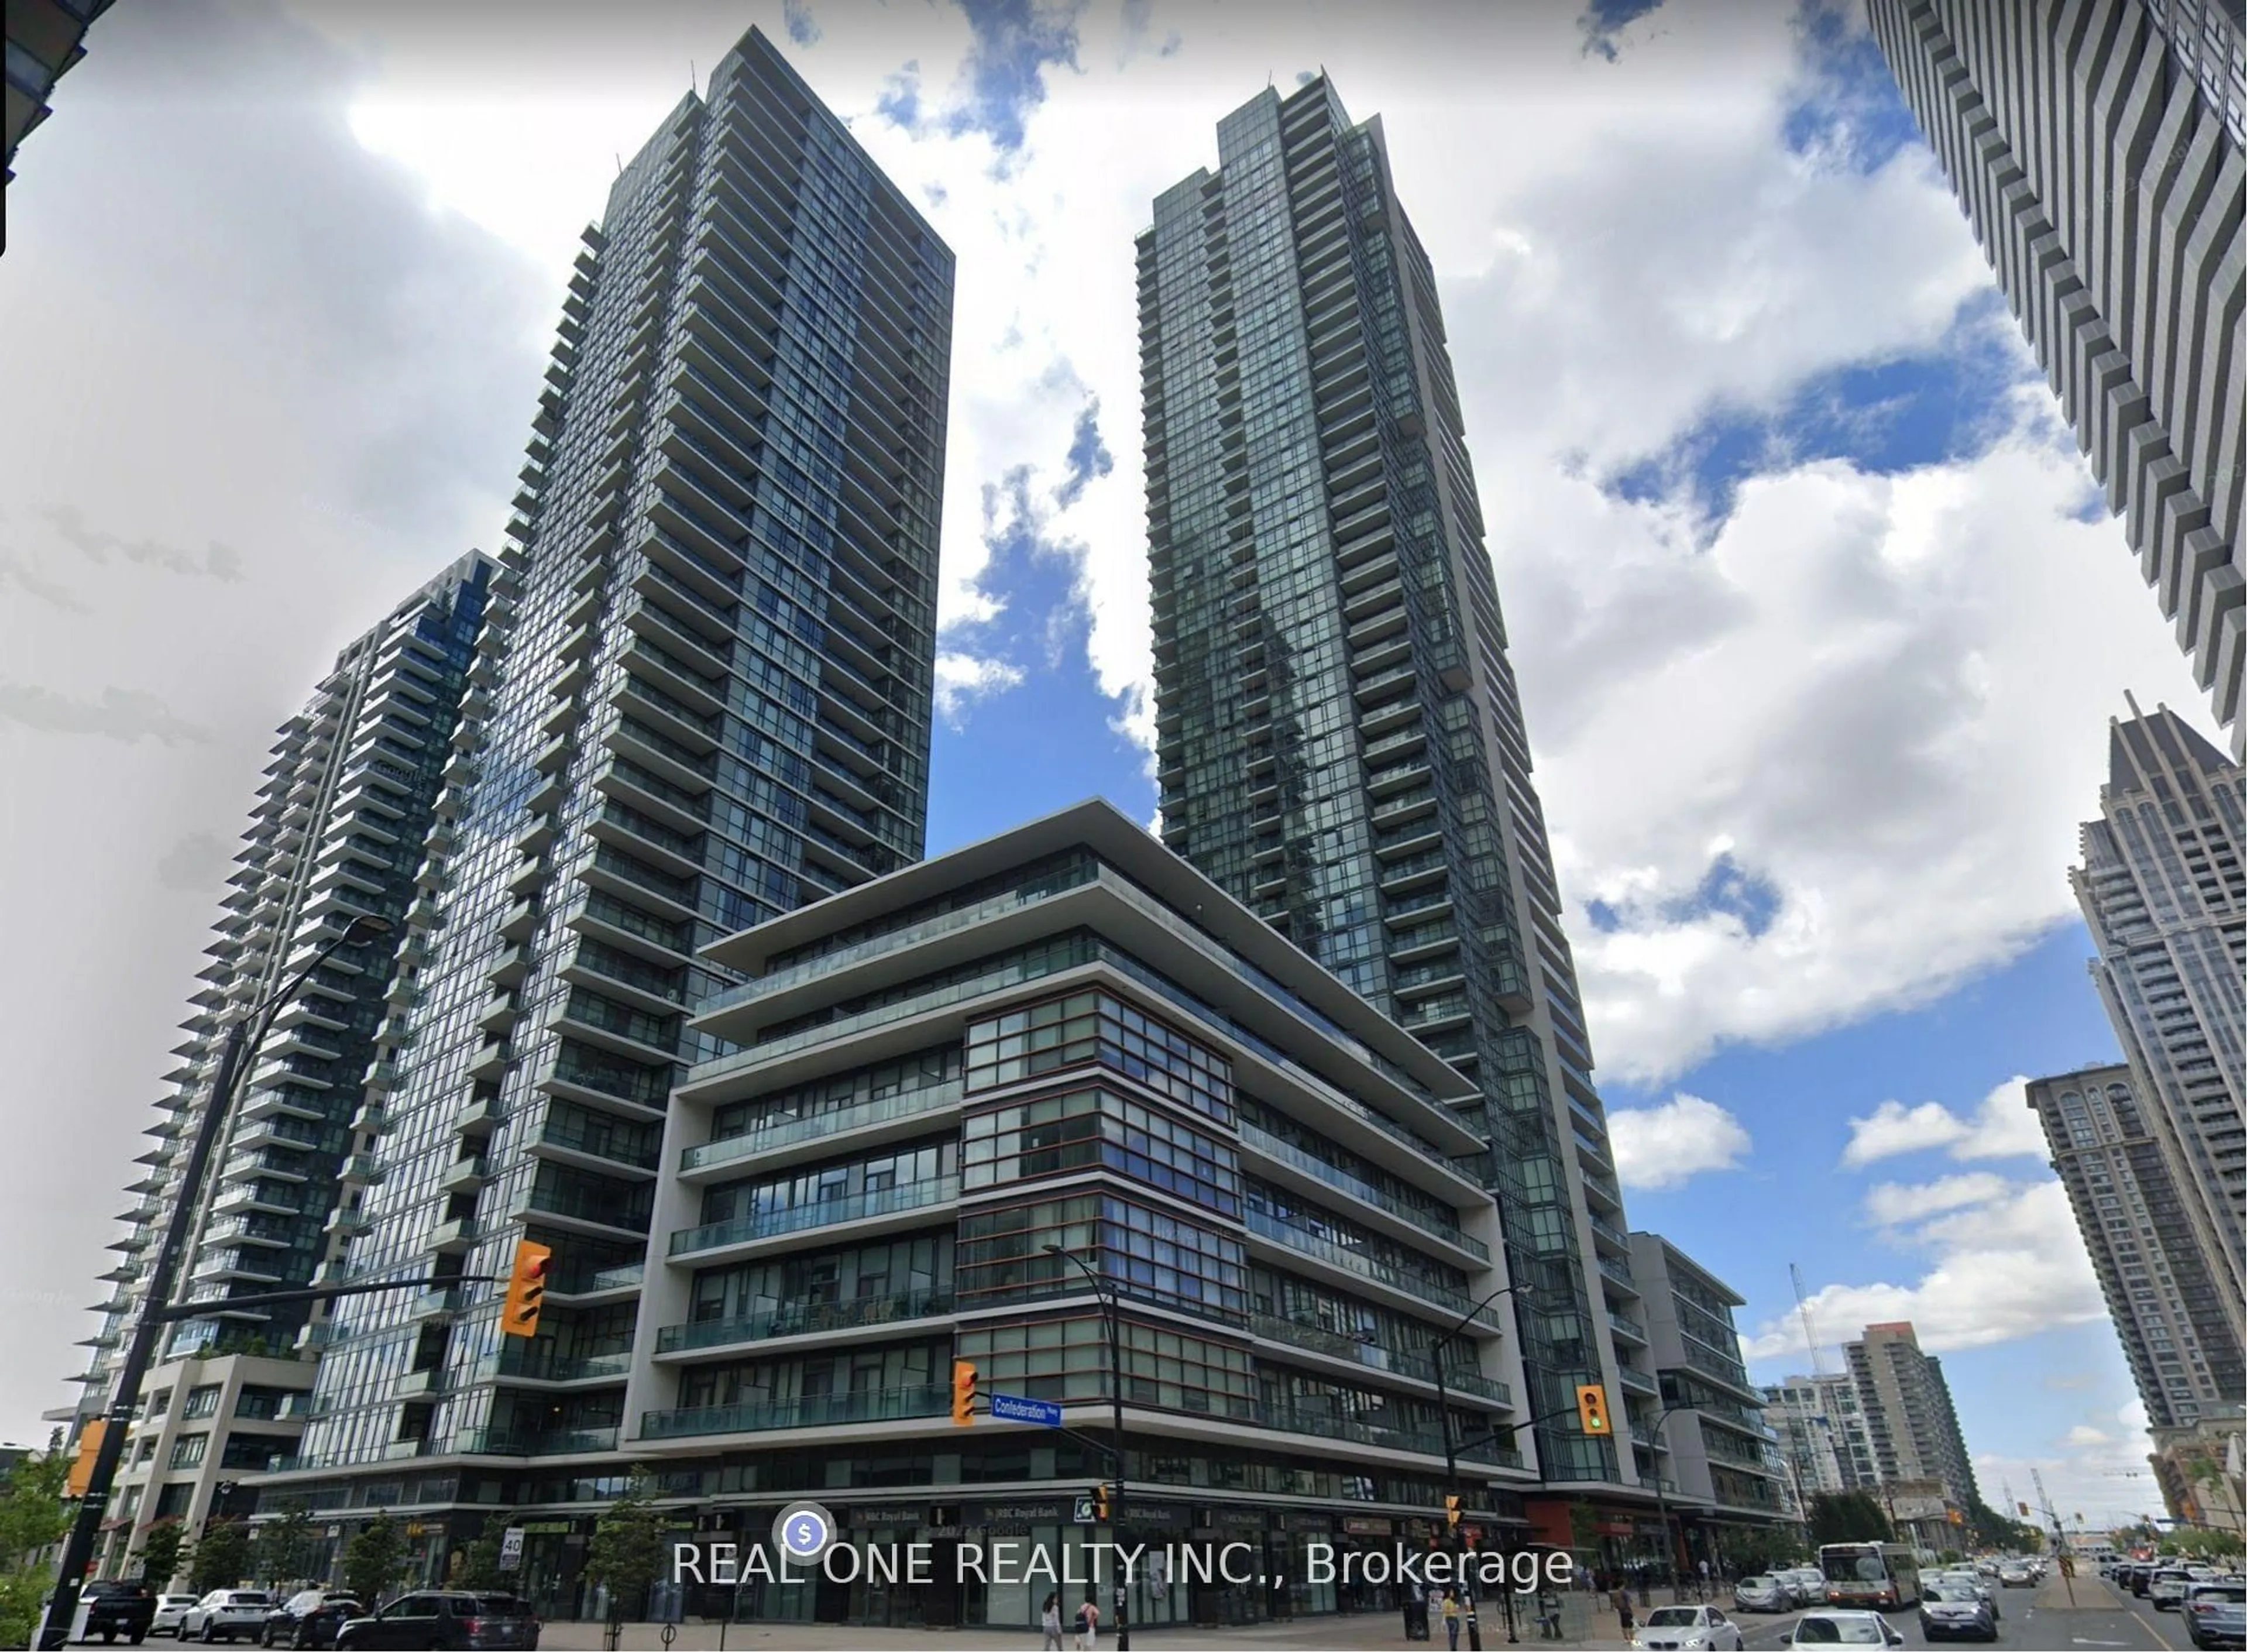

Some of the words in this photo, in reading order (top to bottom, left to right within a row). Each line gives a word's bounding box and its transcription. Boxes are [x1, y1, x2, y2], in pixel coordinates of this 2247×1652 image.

[995, 1397, 1046, 1419] Confederation
[1015, 1507, 1036, 1520] Royal
[1038, 1506, 1058, 1517] Bank
[505, 1540, 521, 1553] 40
